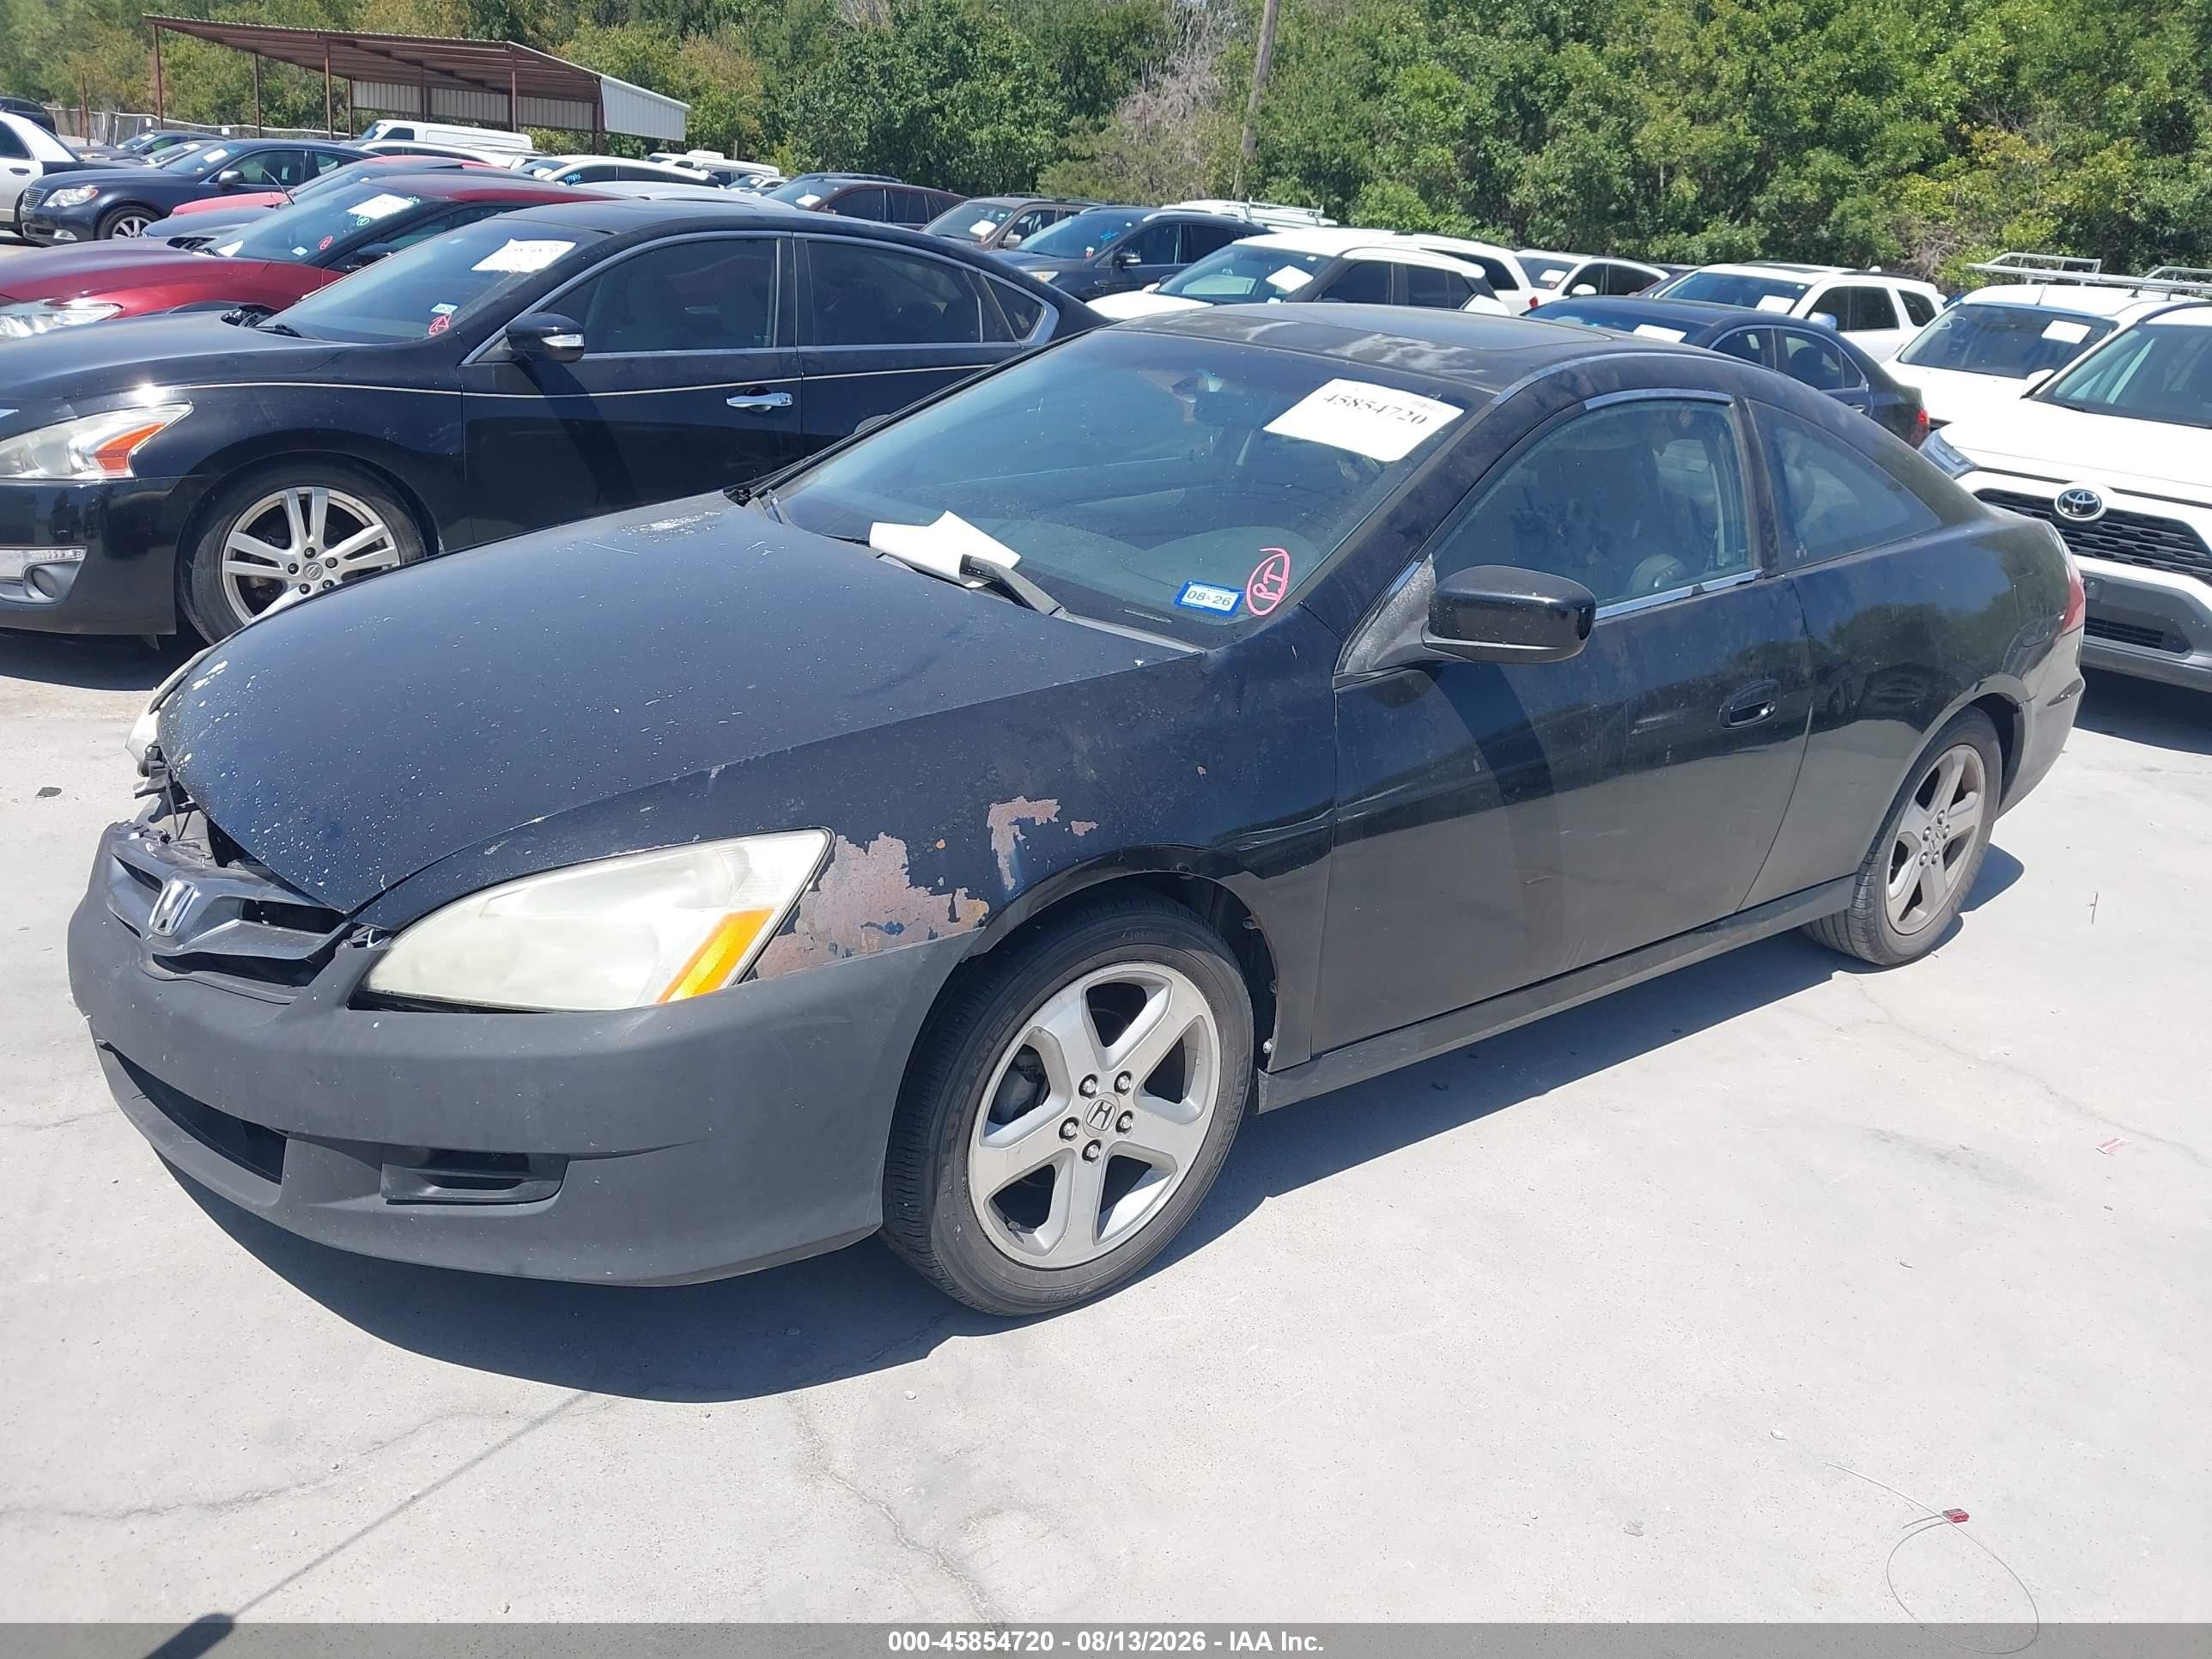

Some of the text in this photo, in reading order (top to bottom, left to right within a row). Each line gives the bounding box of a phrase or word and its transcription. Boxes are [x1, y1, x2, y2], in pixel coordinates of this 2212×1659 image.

[1322, 393, 1428, 425] 45854720
[1187, 590, 1231, 606] 08 26
